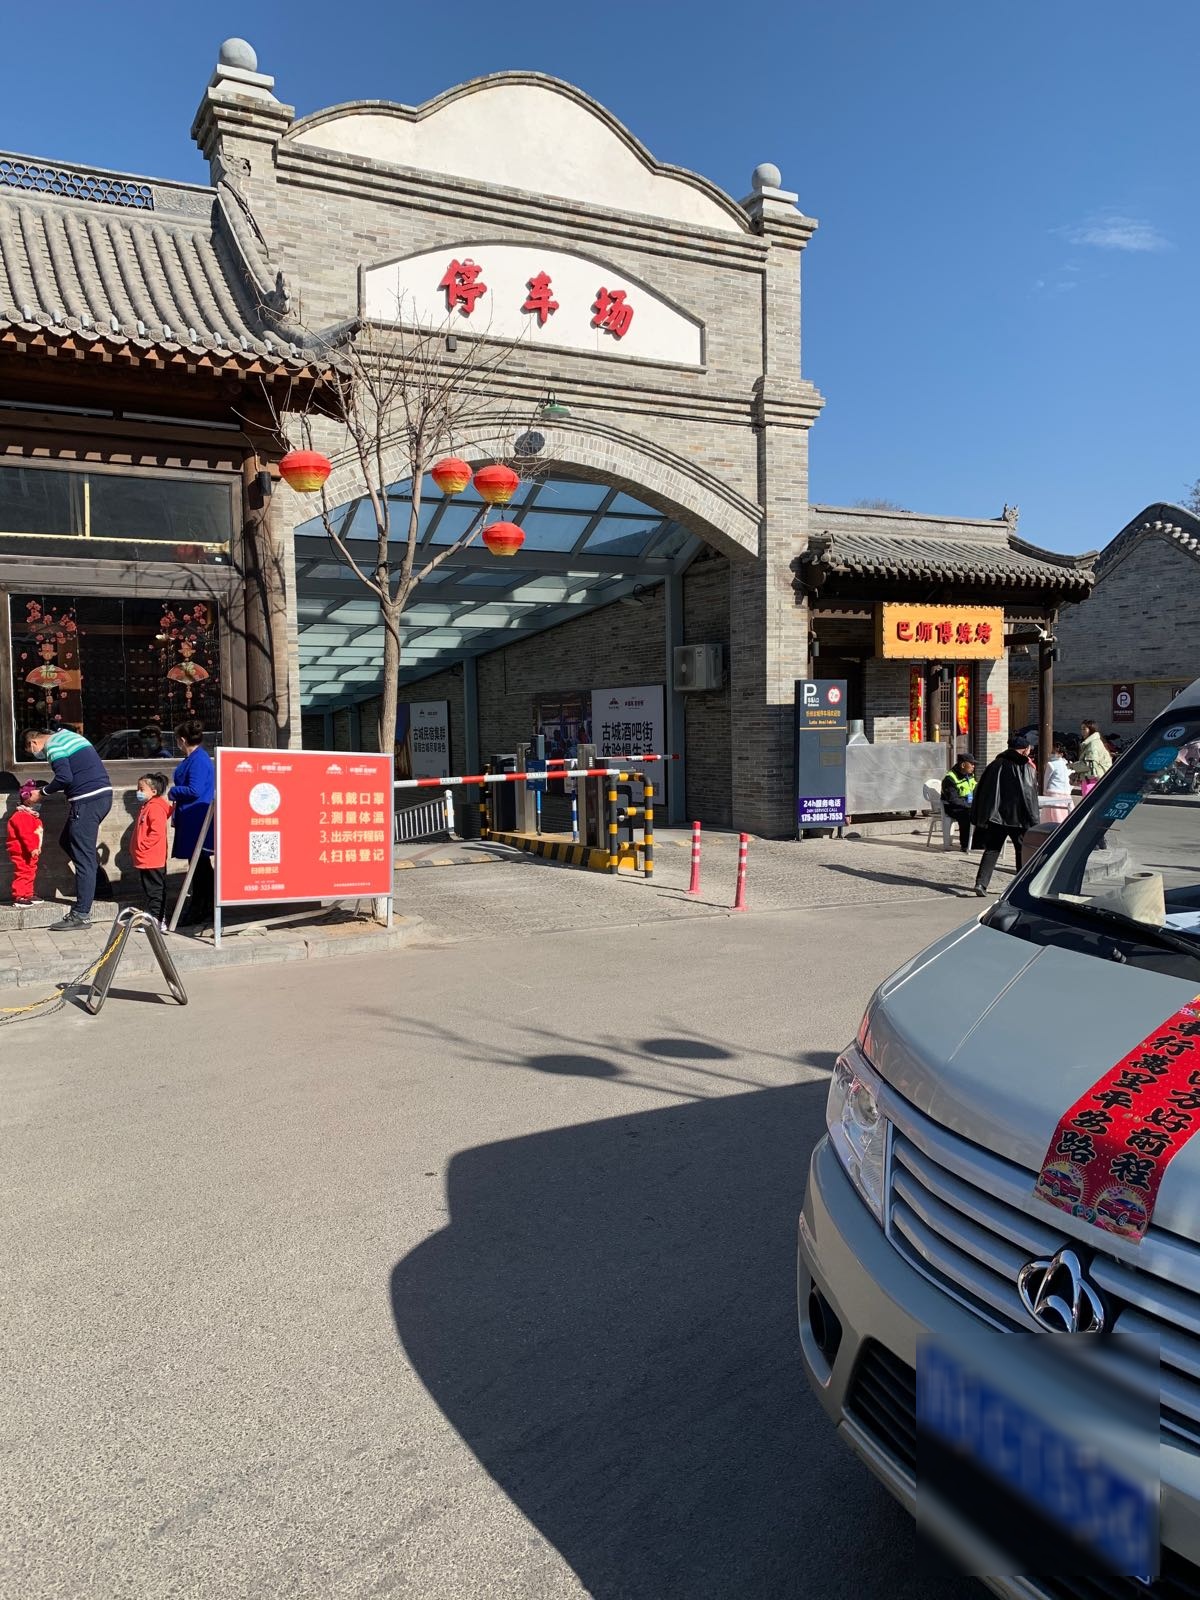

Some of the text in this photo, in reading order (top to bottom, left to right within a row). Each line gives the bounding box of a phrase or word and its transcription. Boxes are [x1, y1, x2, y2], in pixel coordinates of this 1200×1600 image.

[440, 258, 634, 337] 停车场
[896, 620, 992, 644] 巴师傅烧烤
[803, 683, 817, 704] P
[1120, 694, 1128, 705] P
[413, 726, 446, 741] 古城民宿集群
[602, 721, 654, 741] 古城酒吧街
[319, 811, 384, 825] 2.测量体温
[1104, 808, 1127, 819] 2021
[319, 830, 384, 843] 3.出示行程码
[319, 849, 384, 864] 4.扫码登记
